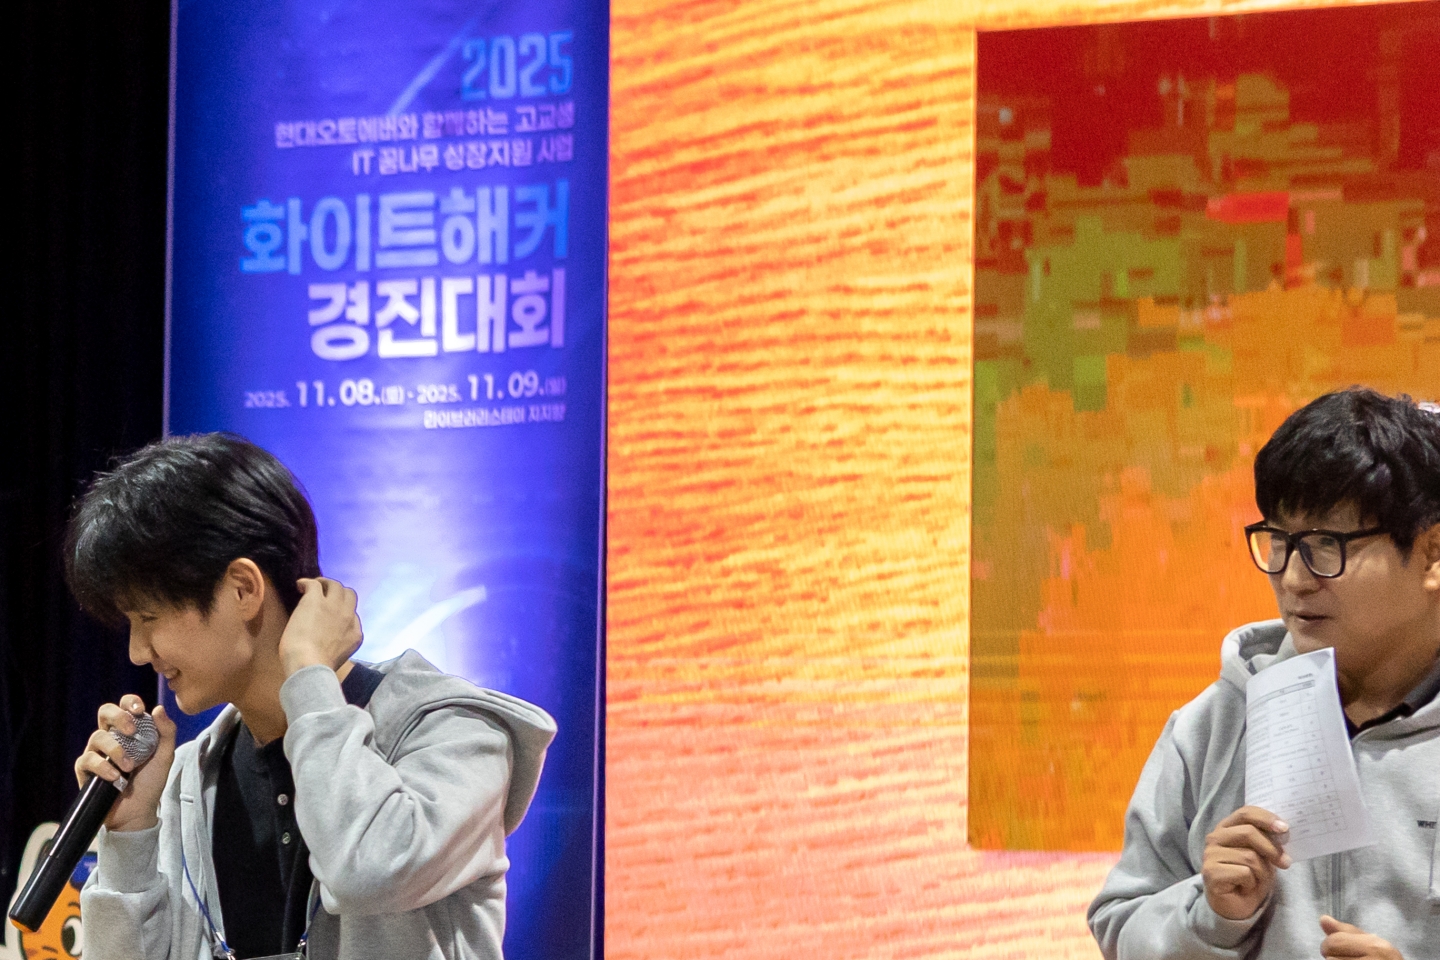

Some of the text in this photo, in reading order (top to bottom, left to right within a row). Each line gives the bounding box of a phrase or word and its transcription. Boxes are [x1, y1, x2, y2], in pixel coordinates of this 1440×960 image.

[462, 32, 574, 100] 2025
[352, 149, 375, 175] IT
[239, 179, 570, 275] 화이트해커
[307, 268, 567, 361] 경진대회
